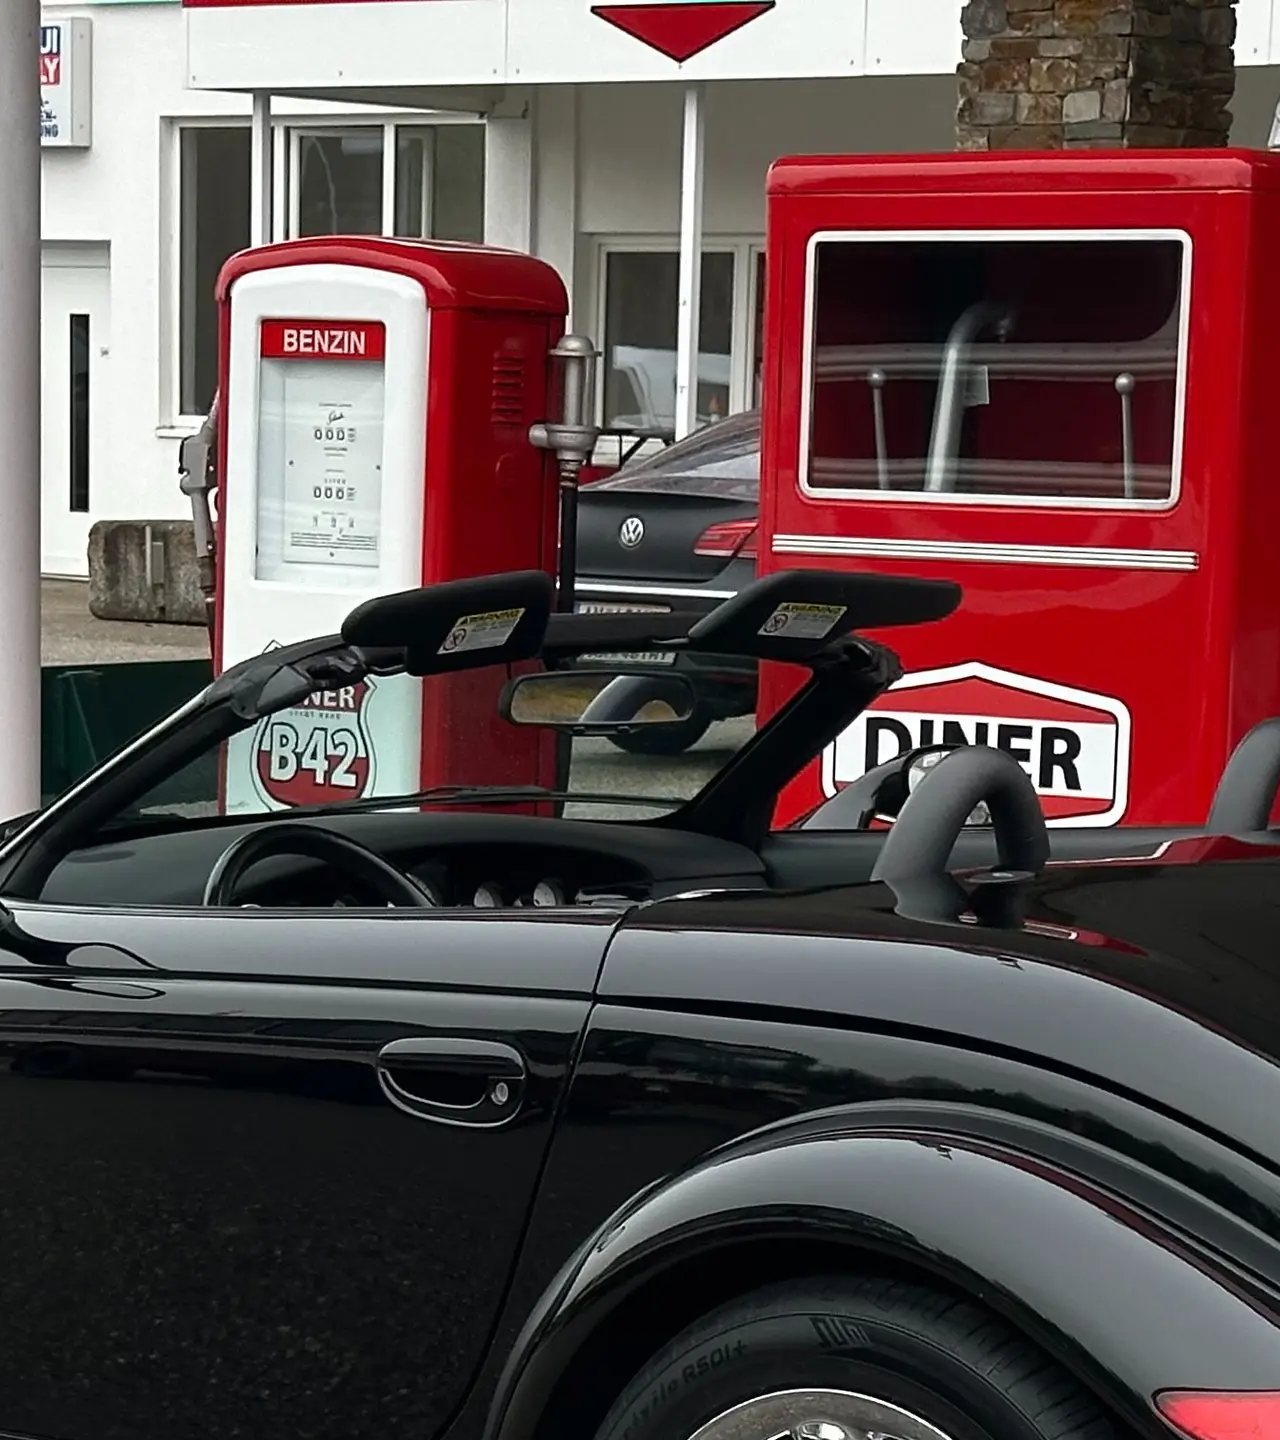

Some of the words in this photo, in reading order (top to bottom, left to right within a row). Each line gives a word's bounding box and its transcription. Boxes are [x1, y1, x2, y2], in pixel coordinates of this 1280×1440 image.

[283, 328, 365, 354] BENZIN
[303, 685, 355, 709] NER
[268, 722, 359, 790] B42
